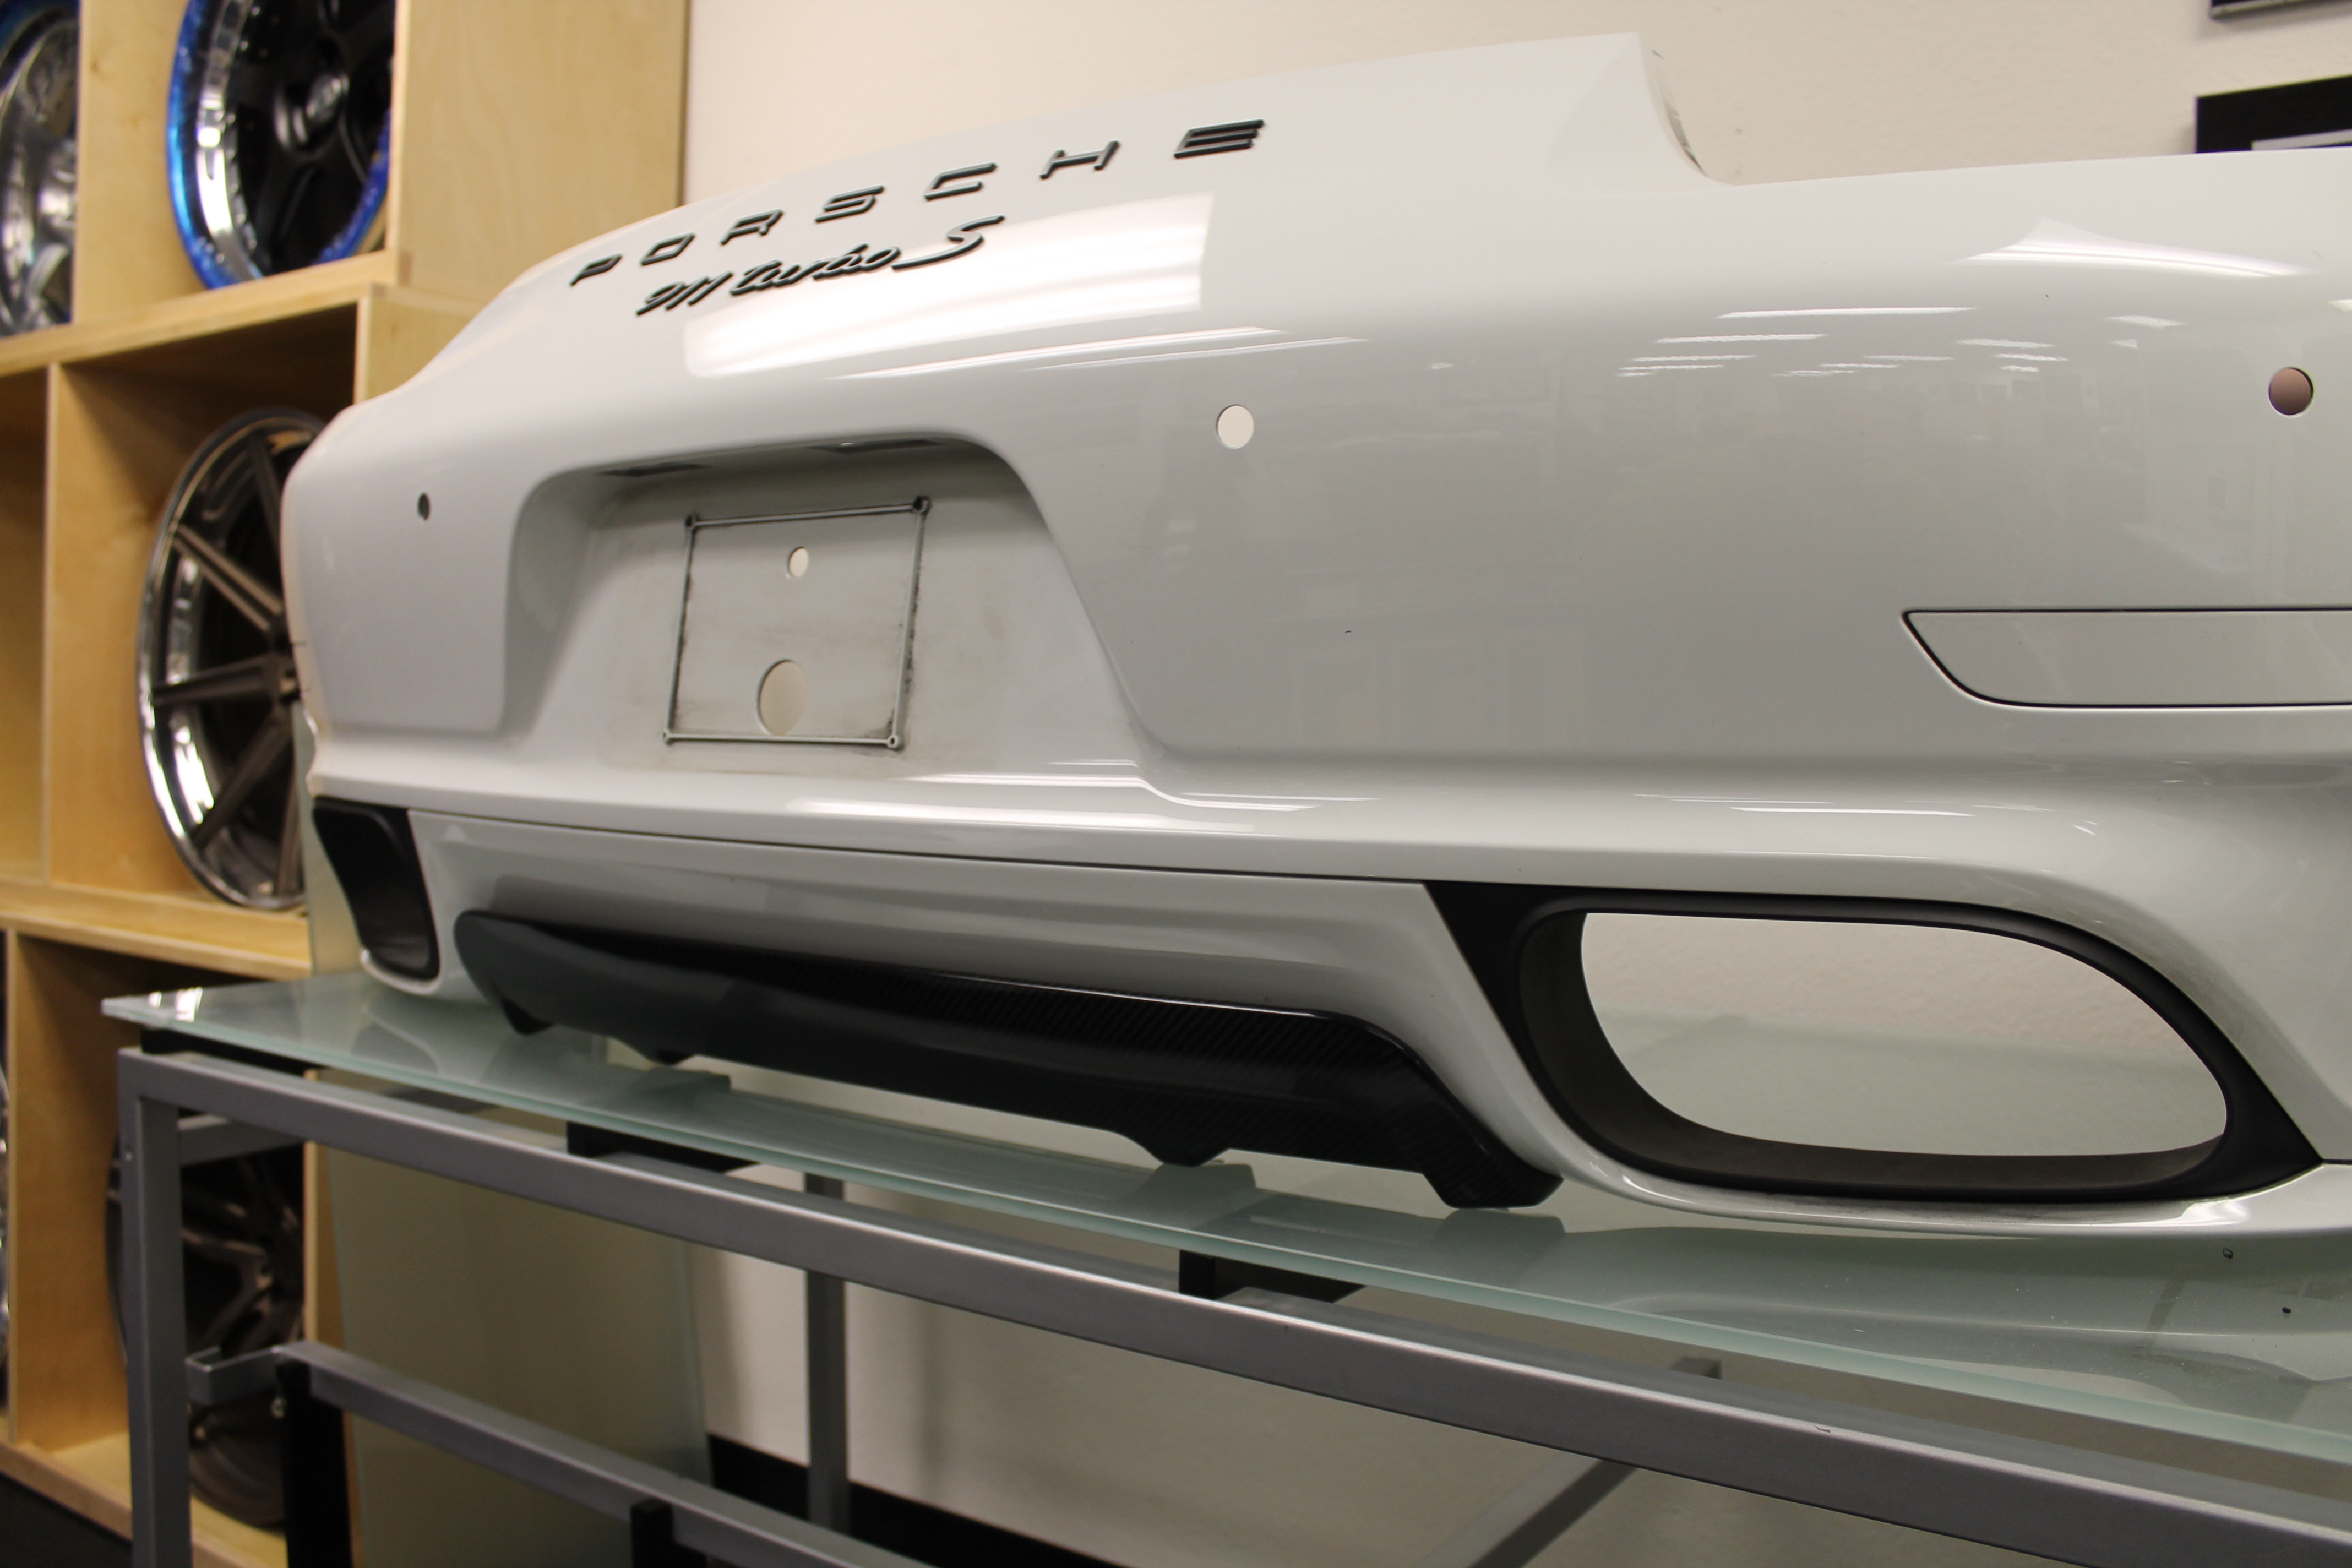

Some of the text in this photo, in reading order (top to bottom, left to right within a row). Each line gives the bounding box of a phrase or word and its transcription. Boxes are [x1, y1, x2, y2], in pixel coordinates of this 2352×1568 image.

[569, 117, 1265, 287] PORSCHE
[636, 270, 733, 317] 911
[890, 215, 1005, 270] S
